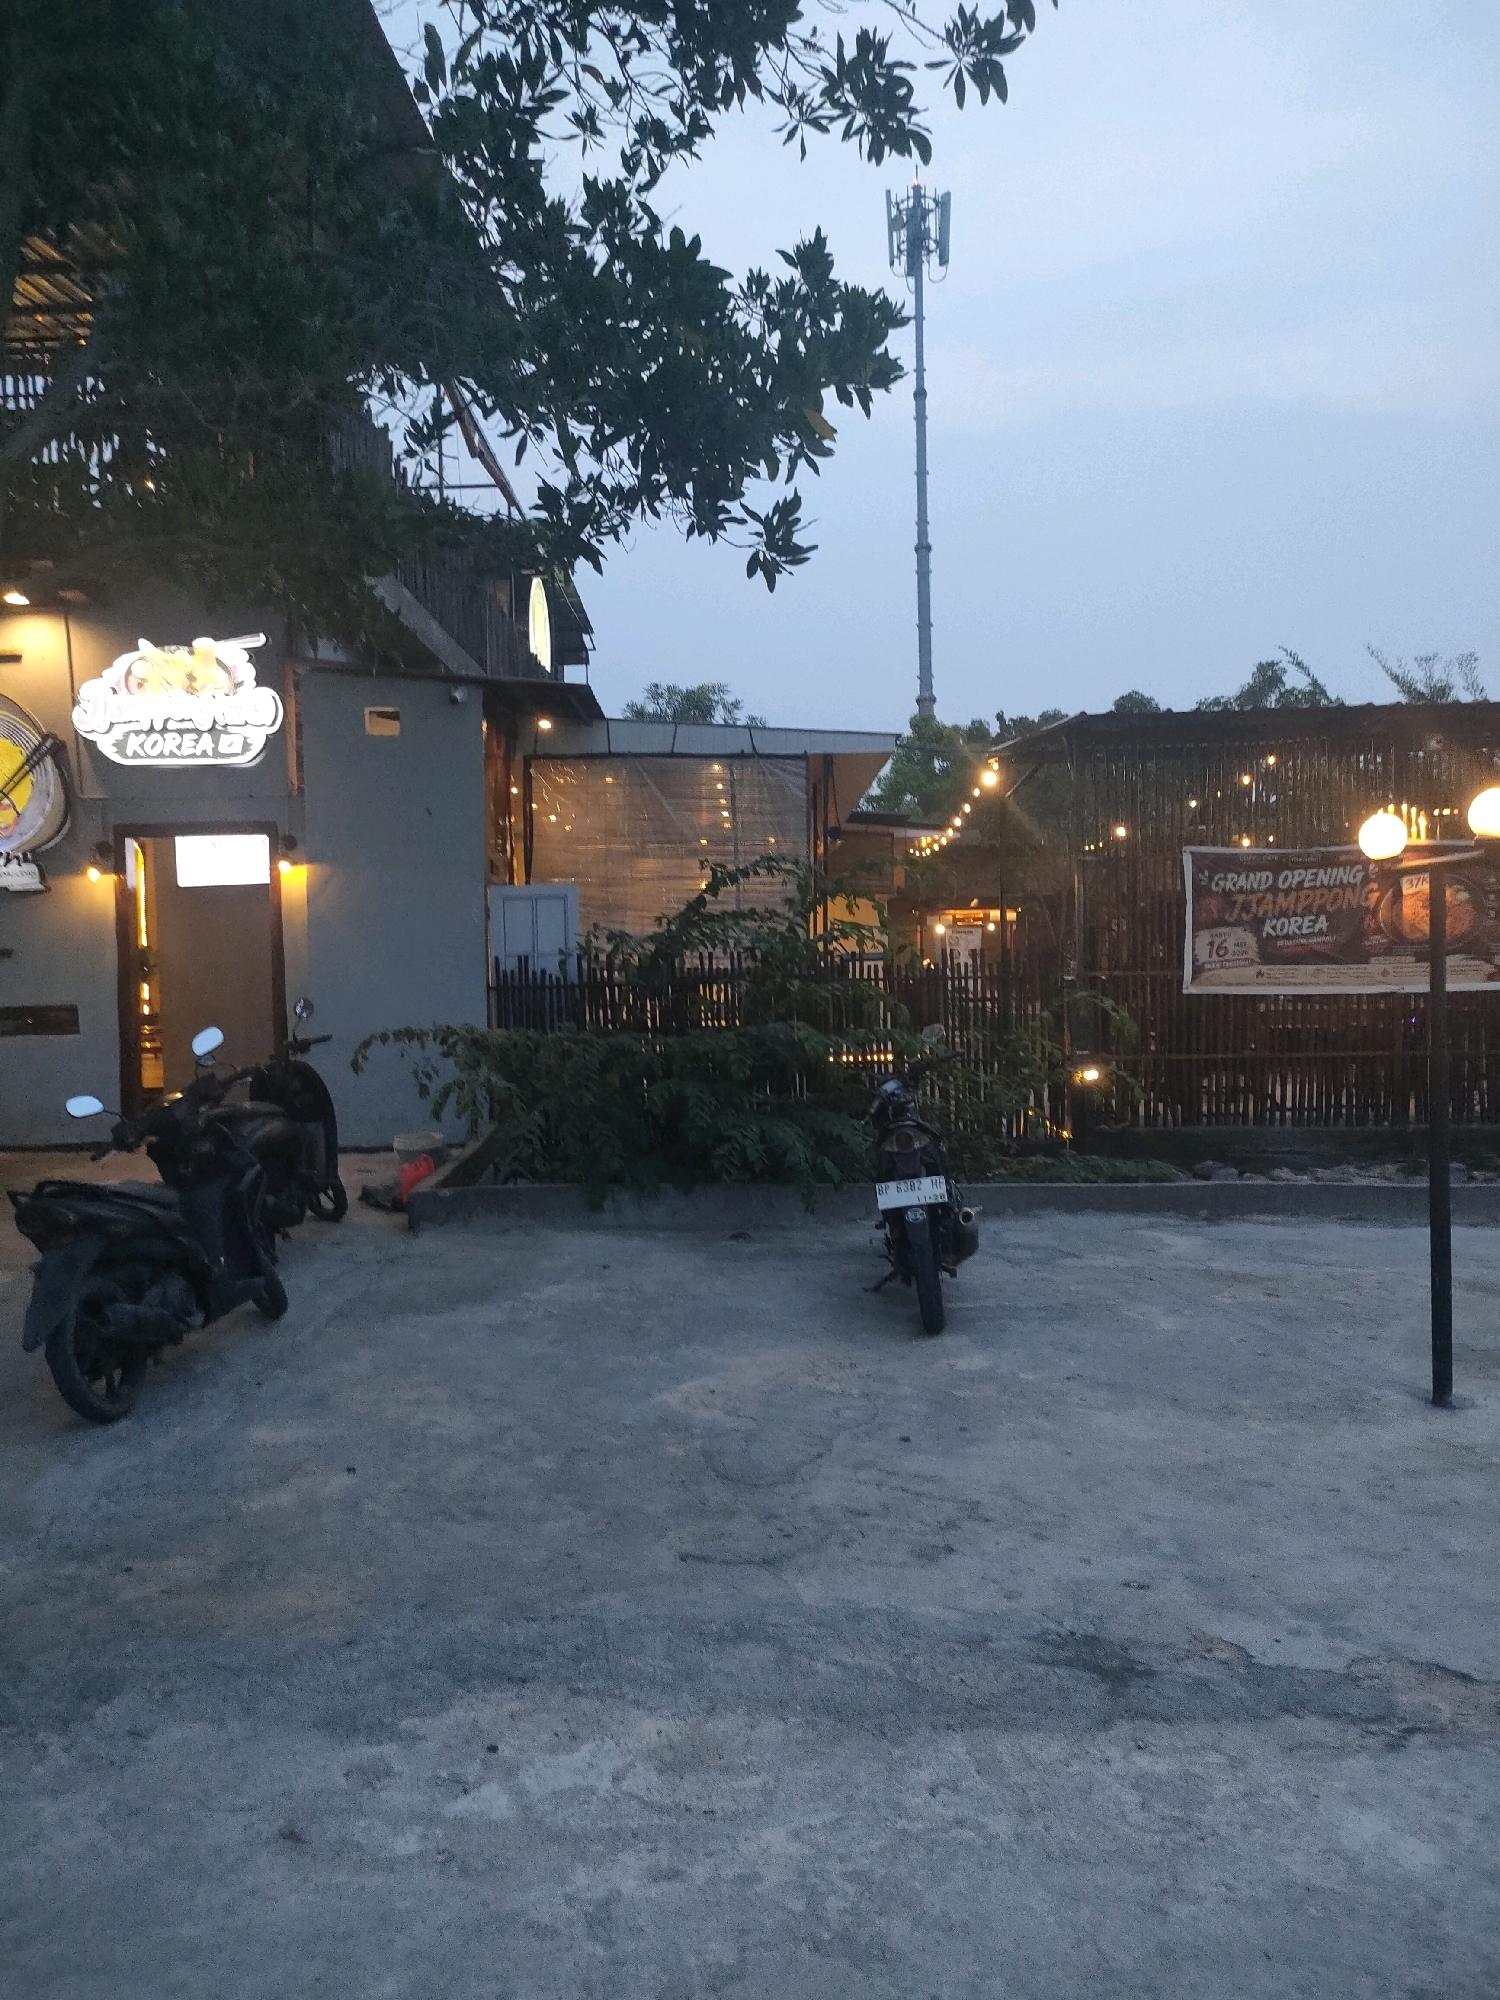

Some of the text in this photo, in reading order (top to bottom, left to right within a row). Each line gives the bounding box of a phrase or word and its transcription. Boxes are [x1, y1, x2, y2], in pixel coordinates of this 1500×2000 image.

[125, 732, 215, 757] KOREA
[1211, 865, 1364, 893] GRAND OPENING
[1224, 883, 1381, 923] JJAMPPONG
[1263, 915, 1329, 938] KOREA
[1206, 939, 1230, 958] 16
[878, 1184, 889, 1196] BP
